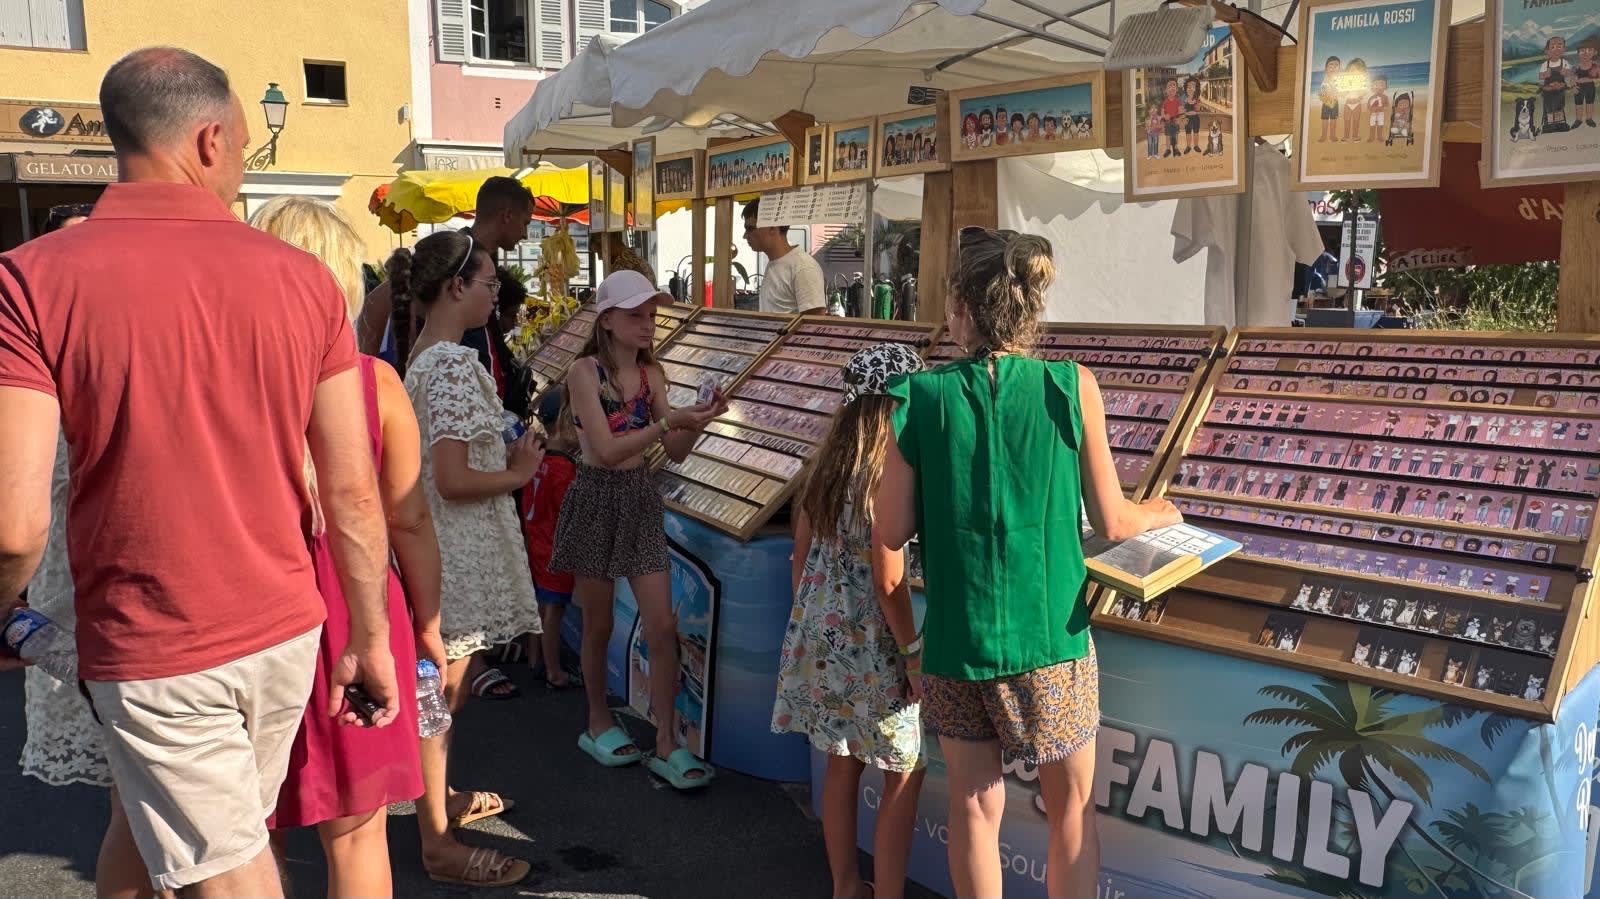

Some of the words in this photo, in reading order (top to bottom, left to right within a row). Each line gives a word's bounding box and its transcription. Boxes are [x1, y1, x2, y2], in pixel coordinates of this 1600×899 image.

[1331, 12, 1380, 31] FAMIGLIA
[1383, 8, 1416, 25] ROSSI
[26, 162, 93, 176] GELATO
[97, 164, 119, 176] AL
[1518, 197, 1564, 220] d'A
[1096, 725, 1414, 888] FAMILY
